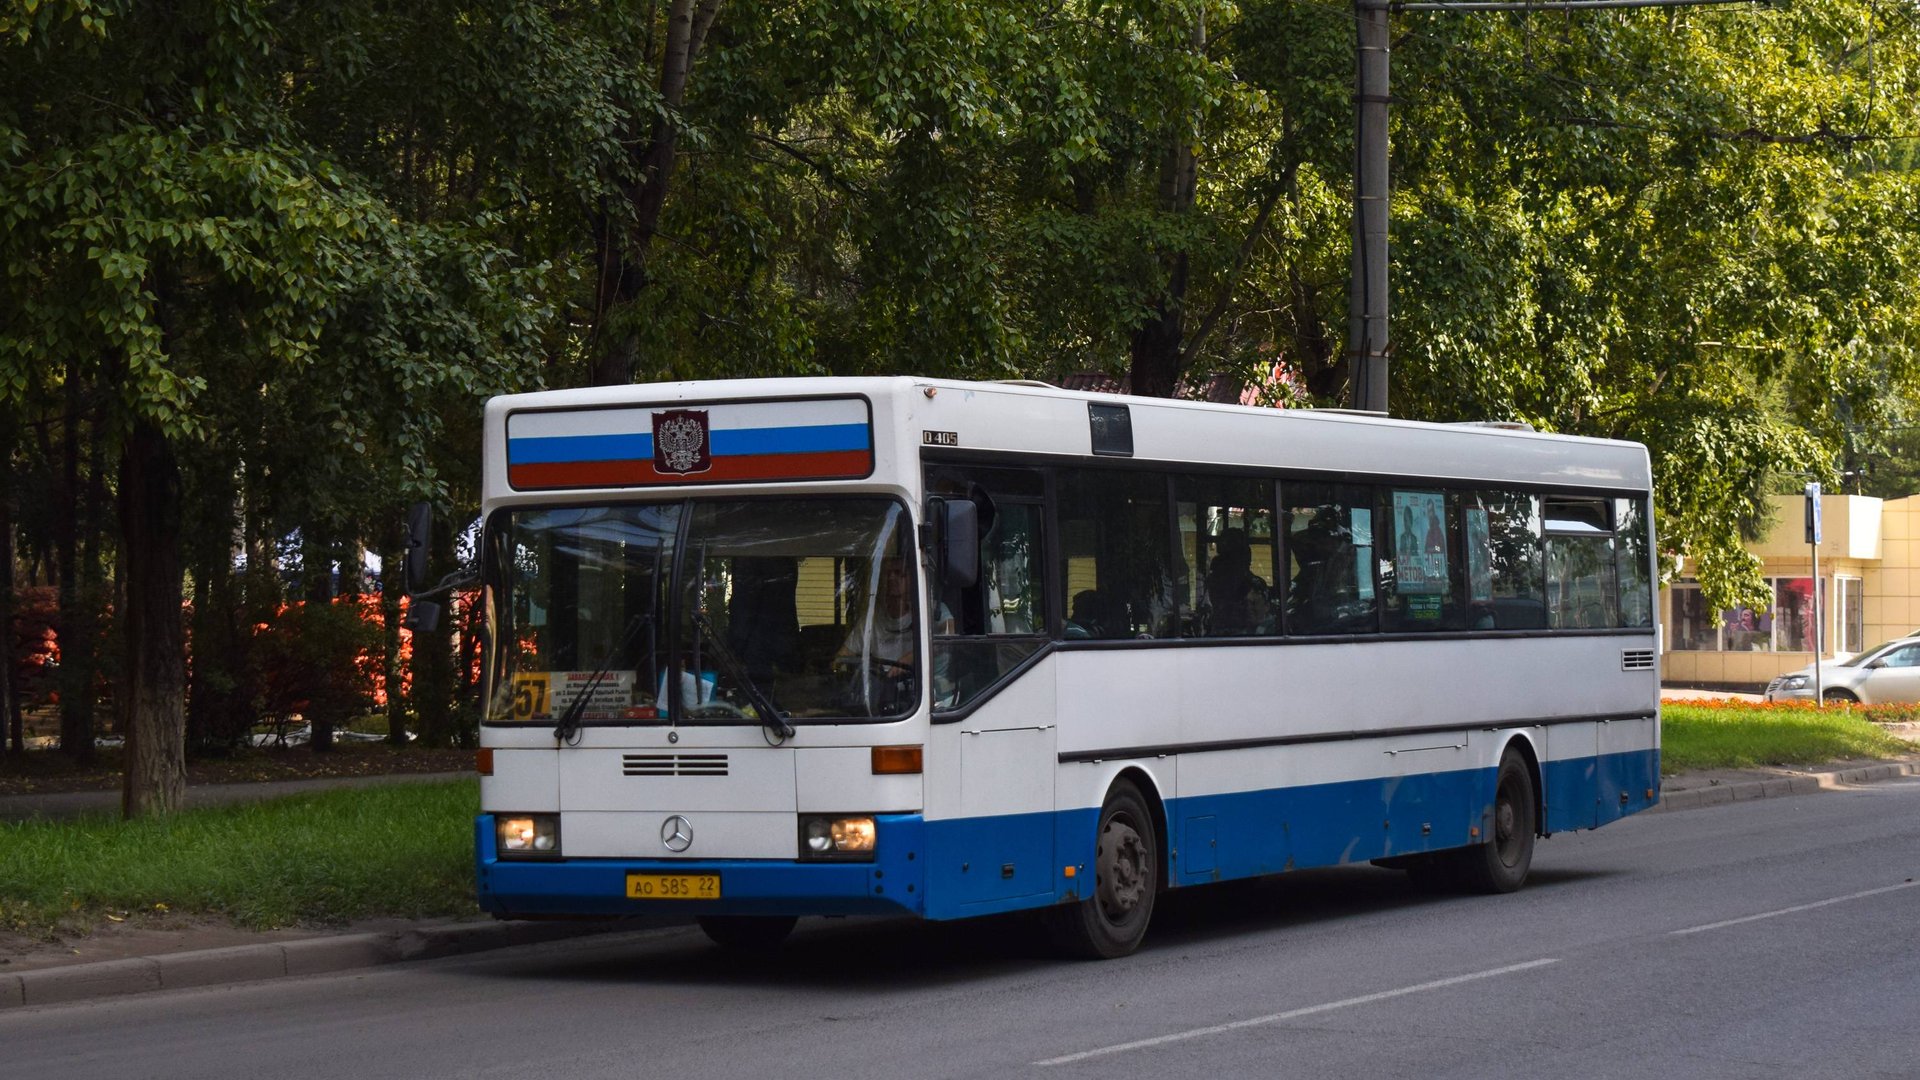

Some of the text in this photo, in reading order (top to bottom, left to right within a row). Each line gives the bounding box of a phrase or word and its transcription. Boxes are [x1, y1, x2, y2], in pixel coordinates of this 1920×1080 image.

[934, 432, 957, 445] 405
[515, 680, 546, 717] 57
[660, 878, 689, 895] 585
[699, 877, 715, 891] 22
